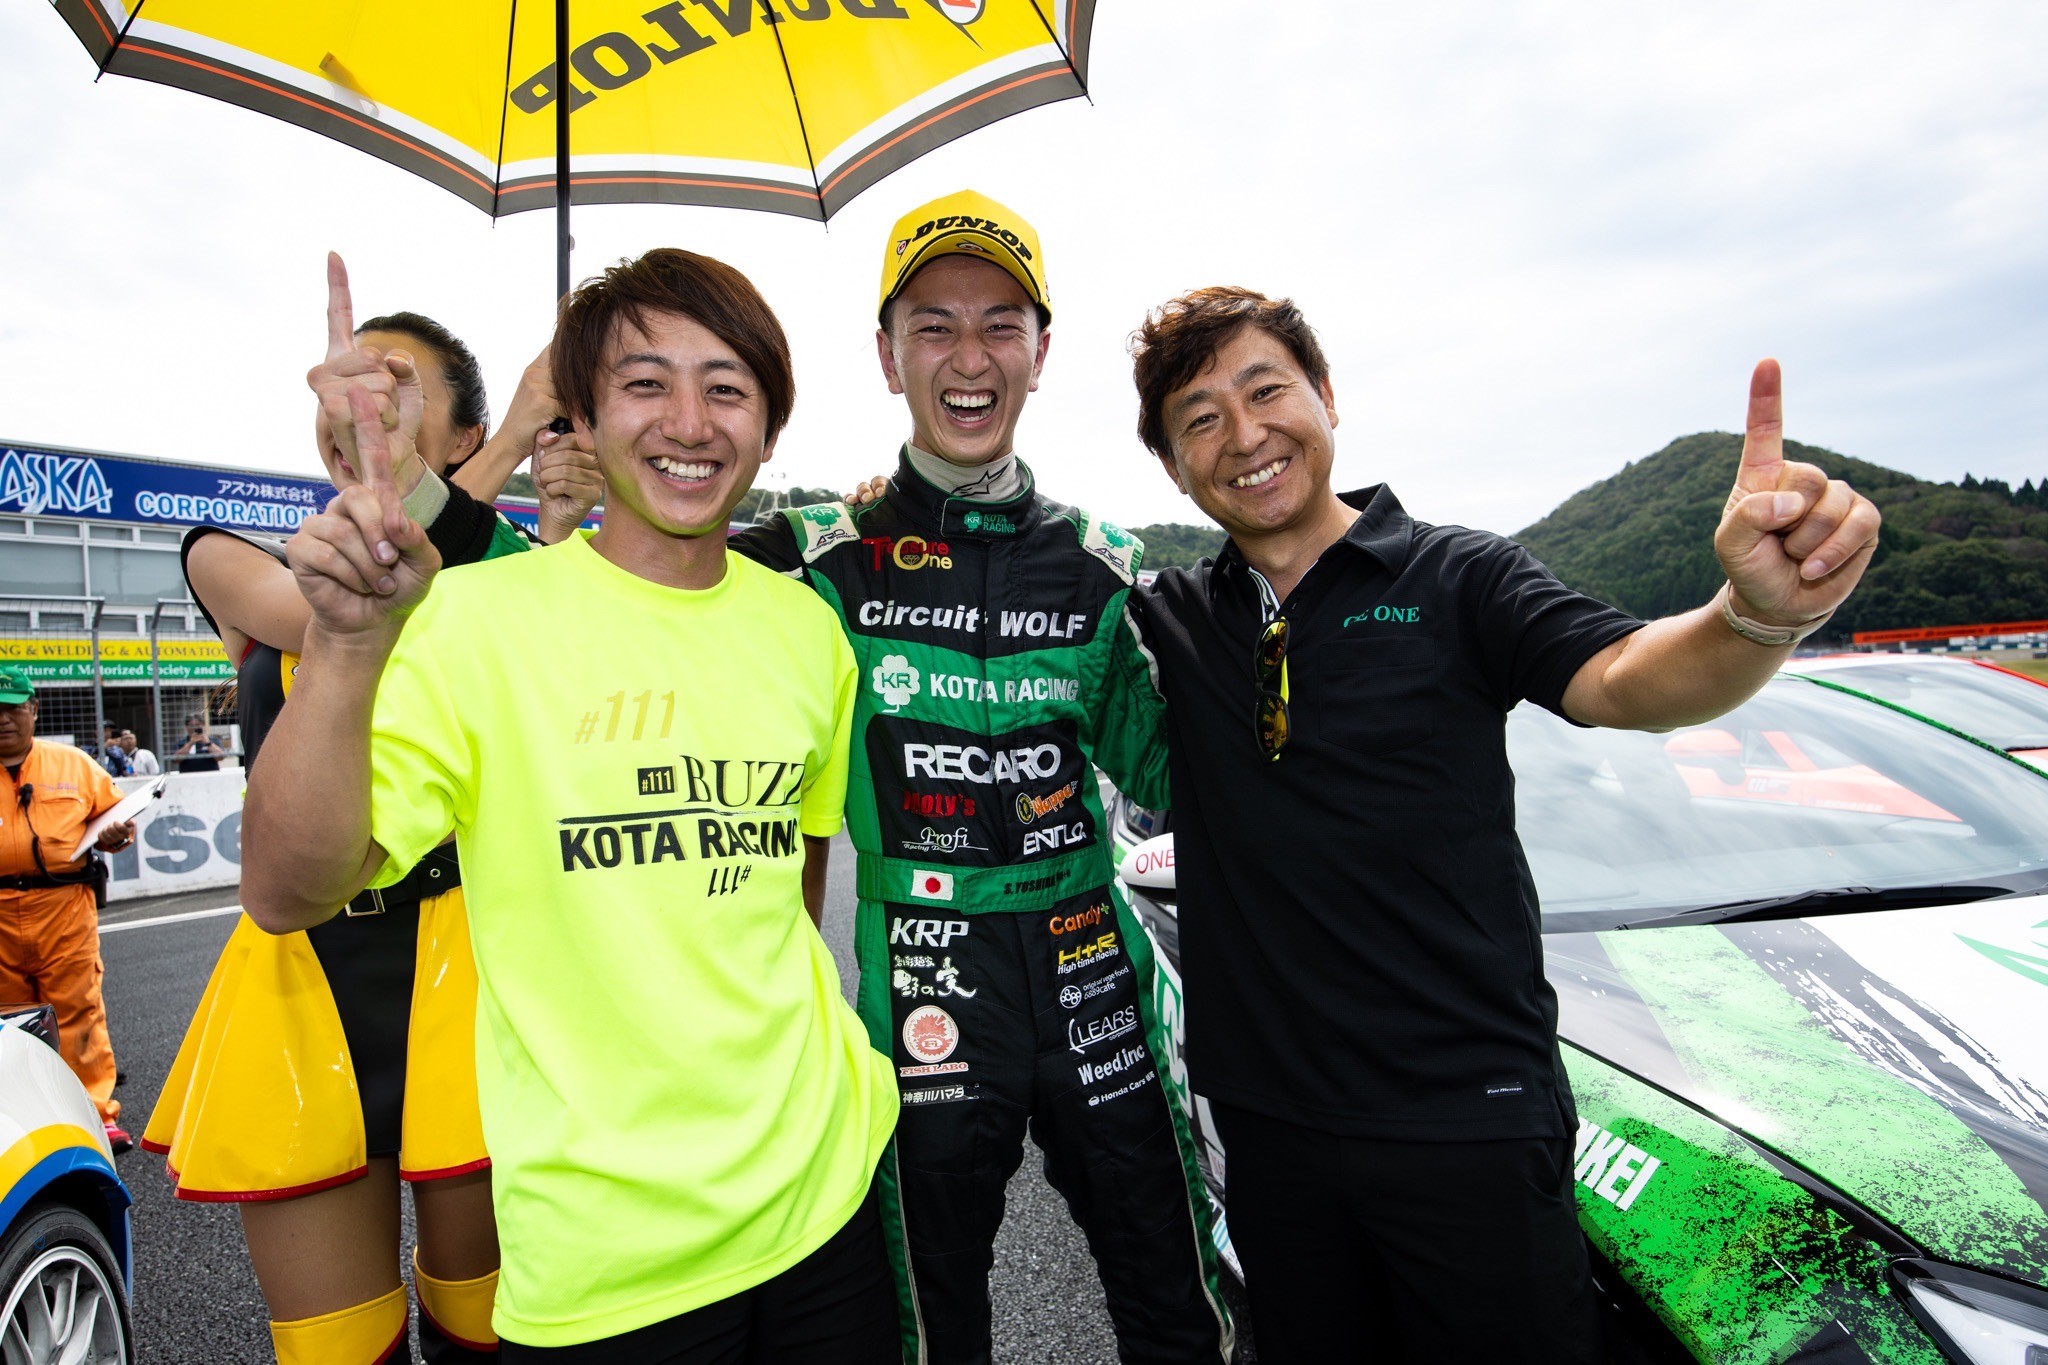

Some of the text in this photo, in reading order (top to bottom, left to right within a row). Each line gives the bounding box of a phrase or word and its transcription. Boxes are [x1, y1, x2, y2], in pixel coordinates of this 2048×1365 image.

[912, 216, 1033, 261] DUNLOP
[0, 449, 113, 516] ASKA
[217, 479, 316, 504] アスカ株式会社
[983, 514, 1016, 533] KOTA RACING
[893, 535, 953, 571] One
[859, 600, 1087, 639] Circuit WOLF
[1374, 605, 1420, 623] ONE
[42, 645, 115, 656] WELDIG
[15, 664, 56, 676] uture
[59, 663, 73, 676] of
[194, 664, 217, 675] and
[881, 672, 912, 689] KR
[930, 673, 1080, 703] KOTA RACING
[574, 689, 675, 744] #111
[904, 743, 1061, 785] RECARO
[641, 755, 805, 807] #111 BUZZ
[559, 823, 688, 872] KOTA
[920, 827, 969, 853] Profi
[1135, 848, 1175, 874] ONE
[889, 917, 969, 948] KRP
[1057, 946, 1119, 975] High time Racing
[1058, 932, 1117, 965] H+R
[1114, 965, 1129, 977] food
[901, 1062, 968, 1075] FISH LABO
[1100, 1078, 1146, 1102] Honda Cars
